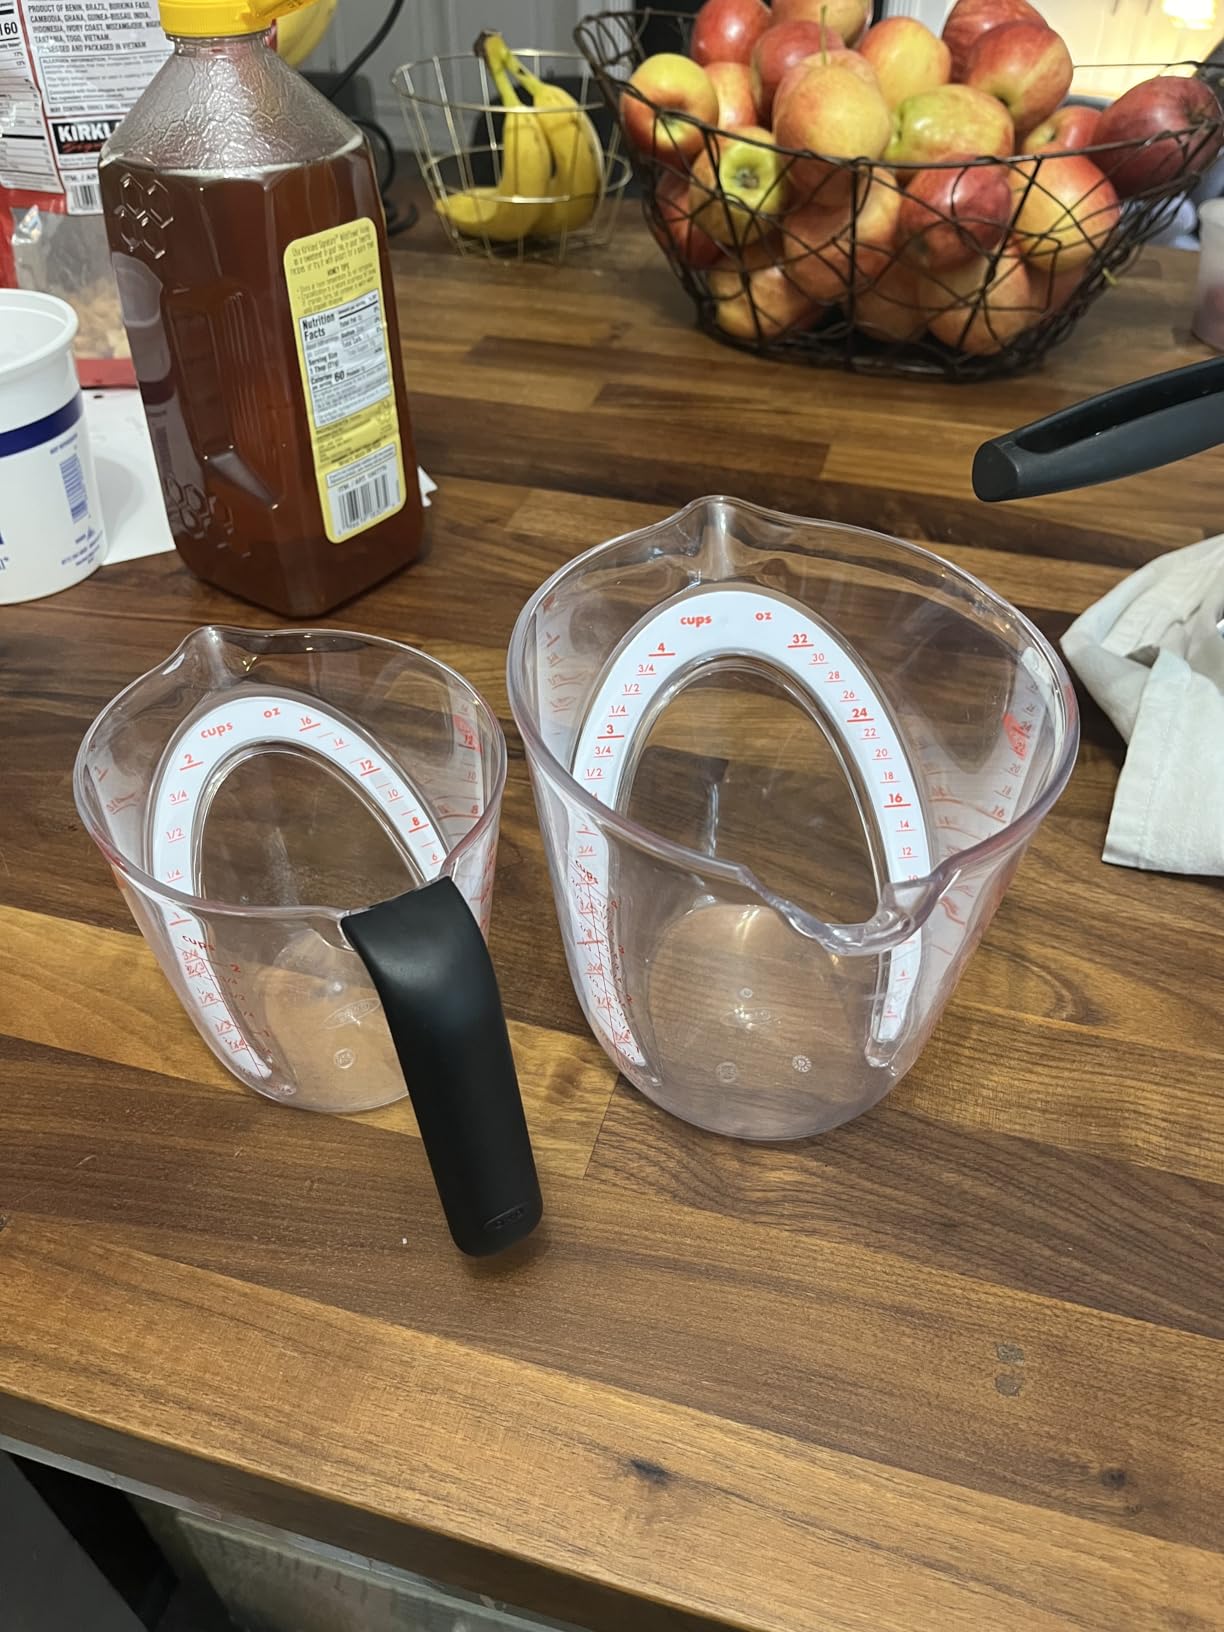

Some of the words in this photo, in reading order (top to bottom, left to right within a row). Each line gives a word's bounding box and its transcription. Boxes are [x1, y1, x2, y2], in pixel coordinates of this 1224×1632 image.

[58, 121, 120, 142] KIRKL
[302, 313, 335, 330] Nutrition
[304, 327, 326, 341] Facts
[334, 370, 345, 382] 60
[680, 615, 712, 628] cups
[755, 612, 772, 621] oz
[792, 634, 808, 644] 32
[657, 643, 666, 653] 4
[812, 653, 825, 662] 30
[638, 665, 655, 673] 3/4
[828, 672, 840, 680] 28
[624, 684, 640, 693] 1/2
[843, 691, 855, 699] 26
[611, 705, 626, 714] 1/4
[851, 708, 868, 718] 24
[201, 722, 233, 739] cups
[264, 707, 281, 718] oz
[300, 716, 312, 726] 16
[606, 725, 614, 735] 3
[864, 729, 876, 737] 22
[334, 738, 344, 747] 14
[595, 747, 611, 755] 3/4
[876, 749, 888, 758] 20
[184, 754, 194, 764] 2
[359, 759, 374, 771] 12
[586, 769, 602, 777] 1/2
[884, 772, 893, 780] 18
[169, 790, 187, 803] 3/4
[387, 788, 399, 799] 10
[888, 793, 903, 803] 16
[412, 816, 420, 826] 8
[900, 821, 909, 829] 14
[166, 828, 183, 841] 1/2
[902, 847, 912, 856] 12
[431, 853, 438, 861] 6
[167, 869, 181, 880] 1/4
